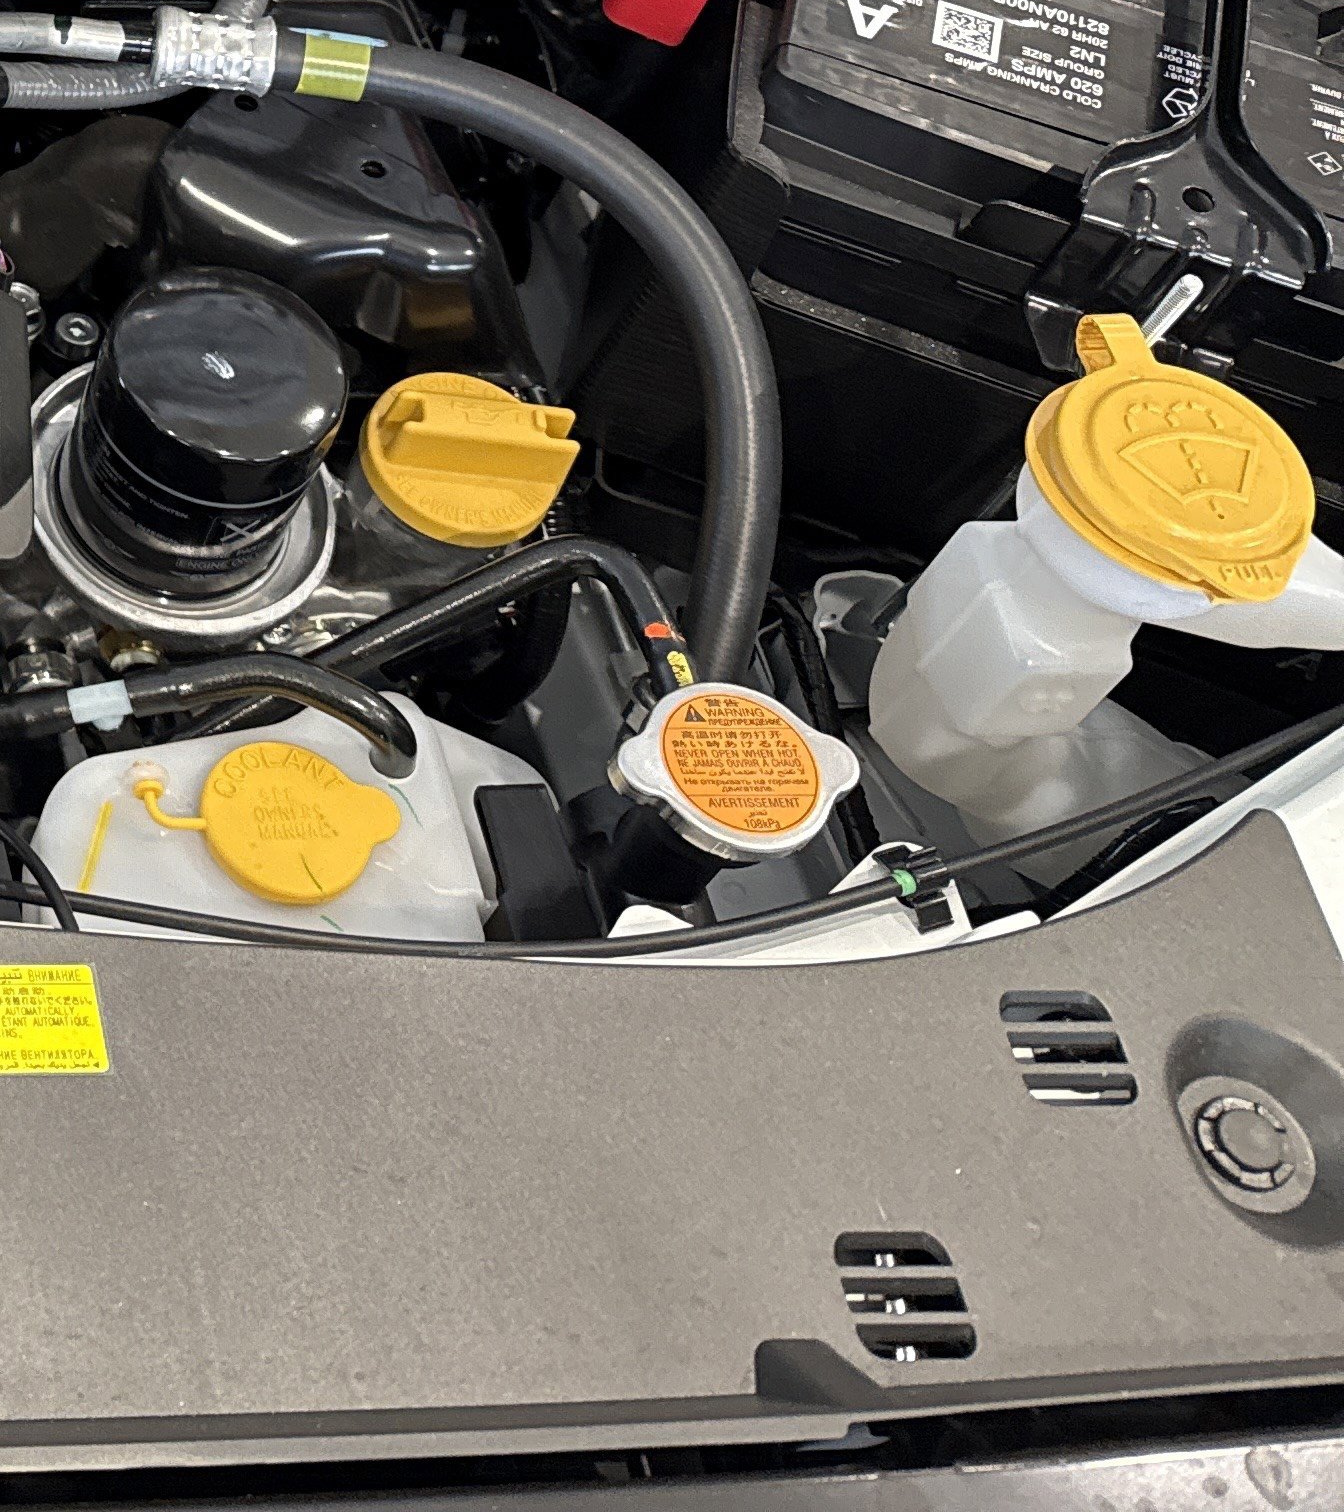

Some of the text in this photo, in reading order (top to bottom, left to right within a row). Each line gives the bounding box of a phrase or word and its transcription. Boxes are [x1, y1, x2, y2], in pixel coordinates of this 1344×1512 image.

[1071, 29, 1109, 49] 20HR
[1021, 45, 1105, 80] GROUP SIZE
[1069, 45, 1106, 67] LN2
[1156, 50, 1183, 66] DOIT
[944, 52, 1102, 109] COLD CRANKING AMPS
[1011, 58, 1104, 97] 620 AMPS
[1163, 70, 1194, 87] MUST
[704, 707, 765, 718] WARNING
[673, 749, 708, 759] NEVER
[712, 749, 740, 759] OPEN
[742, 749, 774, 759] WHEN
[677, 758, 689, 767] NE
[692, 758, 725, 768] JAMAIS
[726, 758, 760, 768] OUVRIR
[213, 745, 345, 800] COOLANT
[708, 797, 801, 809] AVERTISSEMENT
[27, 968, 82, 983] ВНИМАНИЕ
